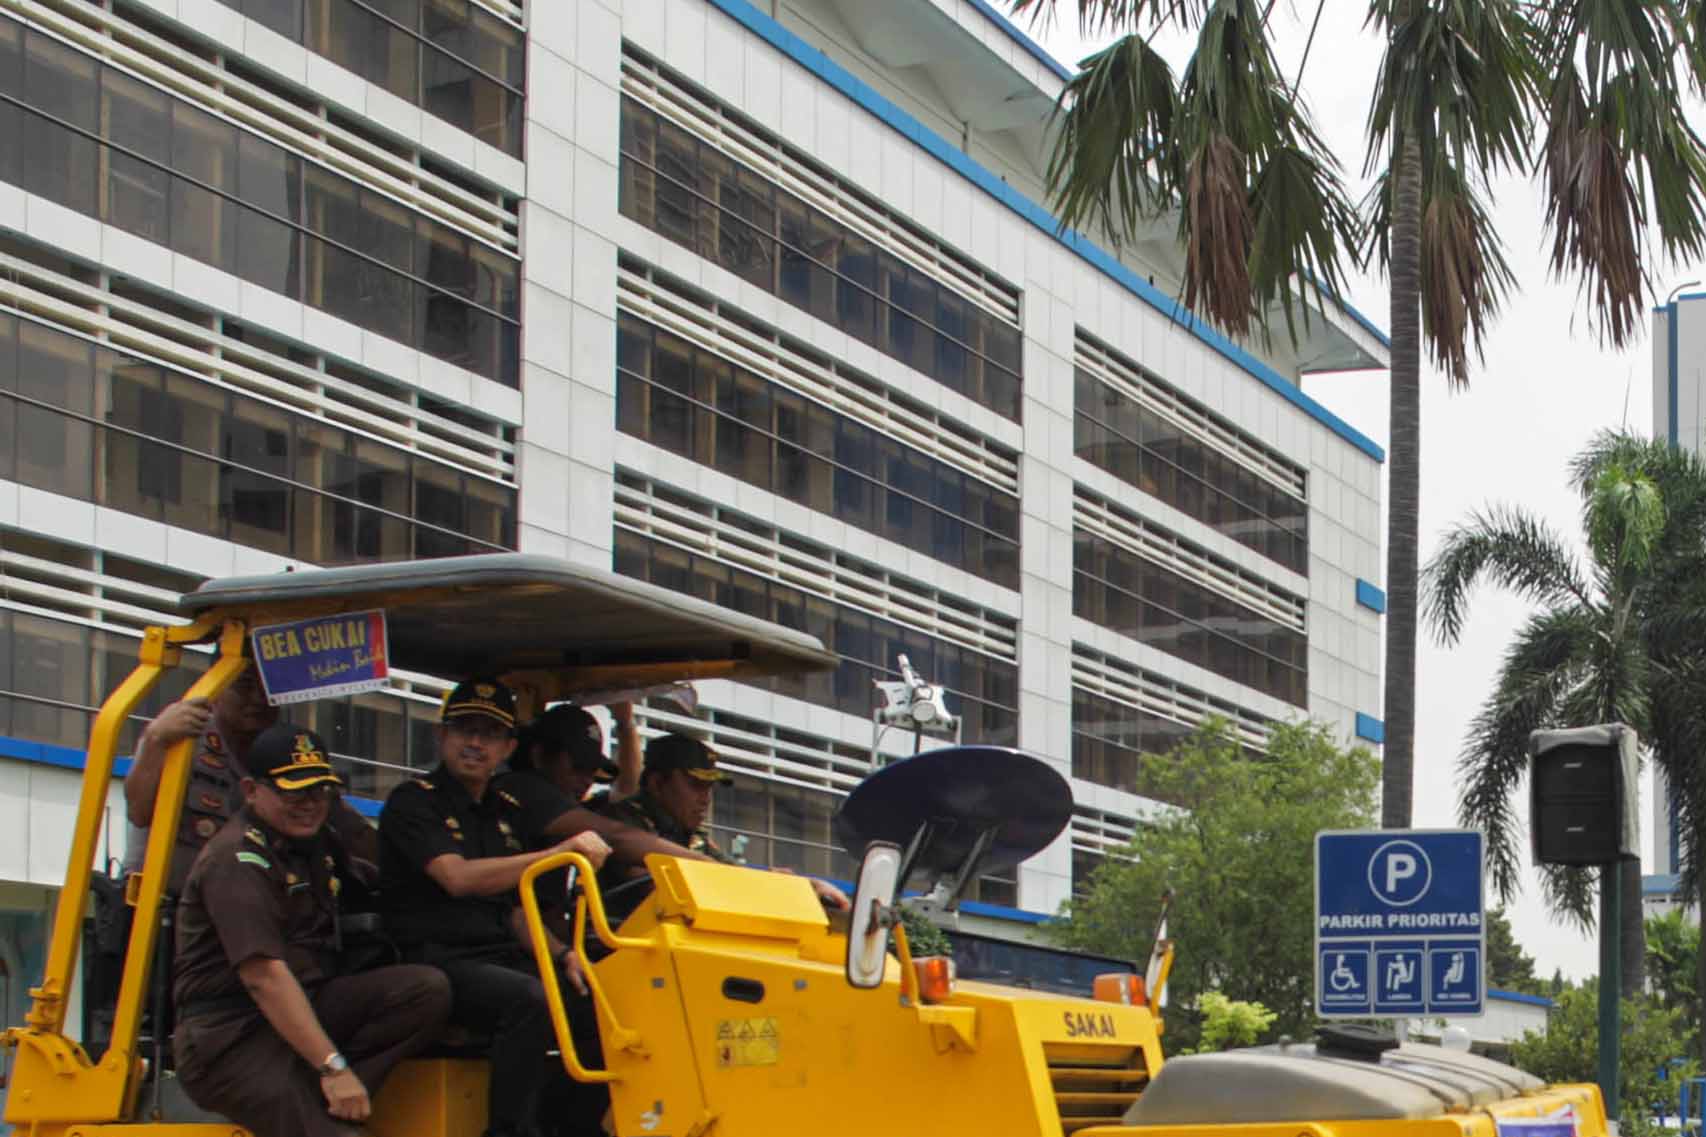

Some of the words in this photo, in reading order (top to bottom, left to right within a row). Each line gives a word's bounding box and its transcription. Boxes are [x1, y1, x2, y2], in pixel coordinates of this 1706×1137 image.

[260, 630, 302, 661] BEA
[304, 621, 366, 654] CUKAI
[1386, 853, 1417, 893] P
[1320, 914, 1384, 929] PARKIR
[1388, 912, 1480, 929] PRIORITAS
[1063, 1010, 1117, 1038] SAKAI
